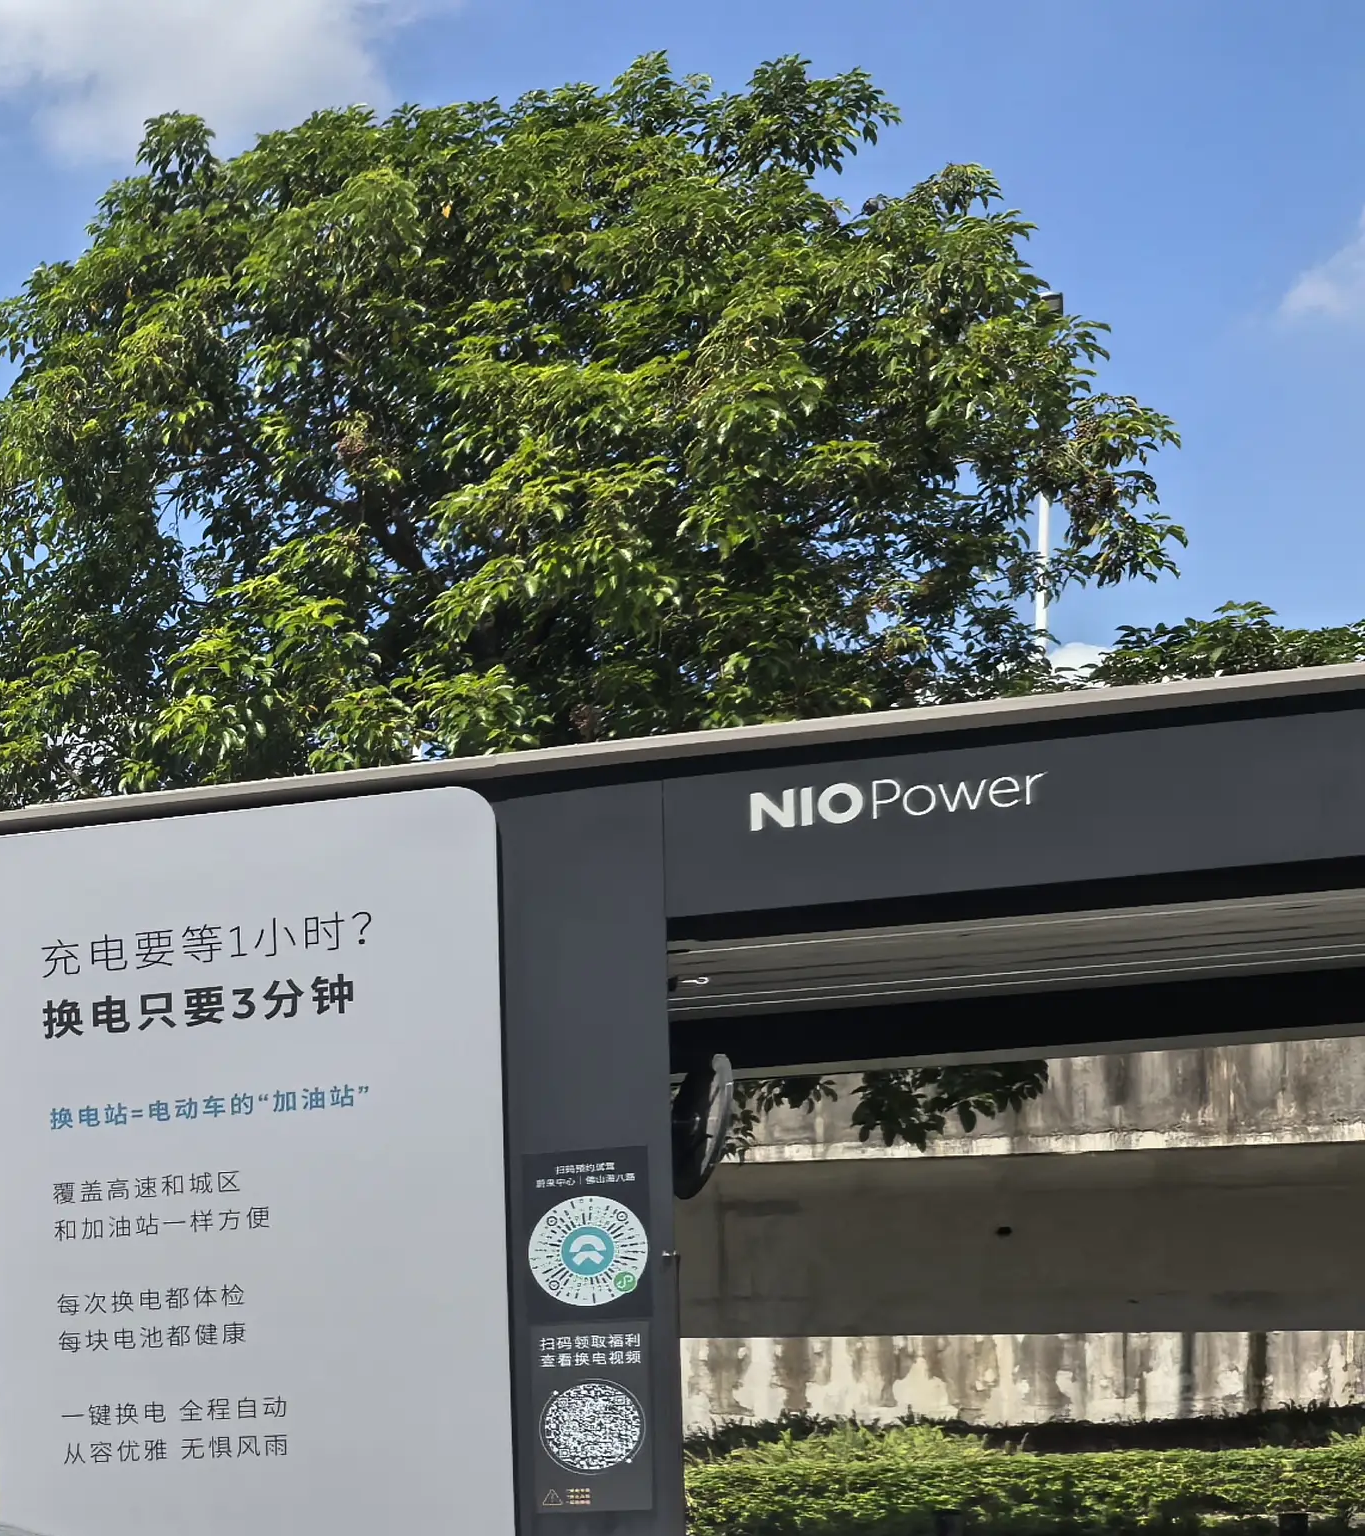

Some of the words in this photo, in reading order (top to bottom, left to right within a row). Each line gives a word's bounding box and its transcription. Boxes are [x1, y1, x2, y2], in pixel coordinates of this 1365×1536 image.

[41, 911, 373, 979] 充电要等1小时？
[42, 973, 355, 1040] 换电只要3分钟
[49, 1084, 370, 1131] 换电站=电动车的“加油站”
[53, 1170, 241, 1205] 覆盖高速和城区
[54, 1206, 271, 1242] 和加油站一样方便
[56, 1283, 245, 1316] 每次换电都体检
[58, 1321, 247, 1354] 每块电池都健康
[539, 1333, 642, 1351] 扫码领取福利
[540, 1349, 642, 1368] 查看换电视频
[61, 1400, 167, 1427] 一键换电
[179, 1395, 288, 1422] 全程自动
[63, 1438, 169, 1465] 从容优雅
[180, 1433, 289, 1460] 无惧风雨
